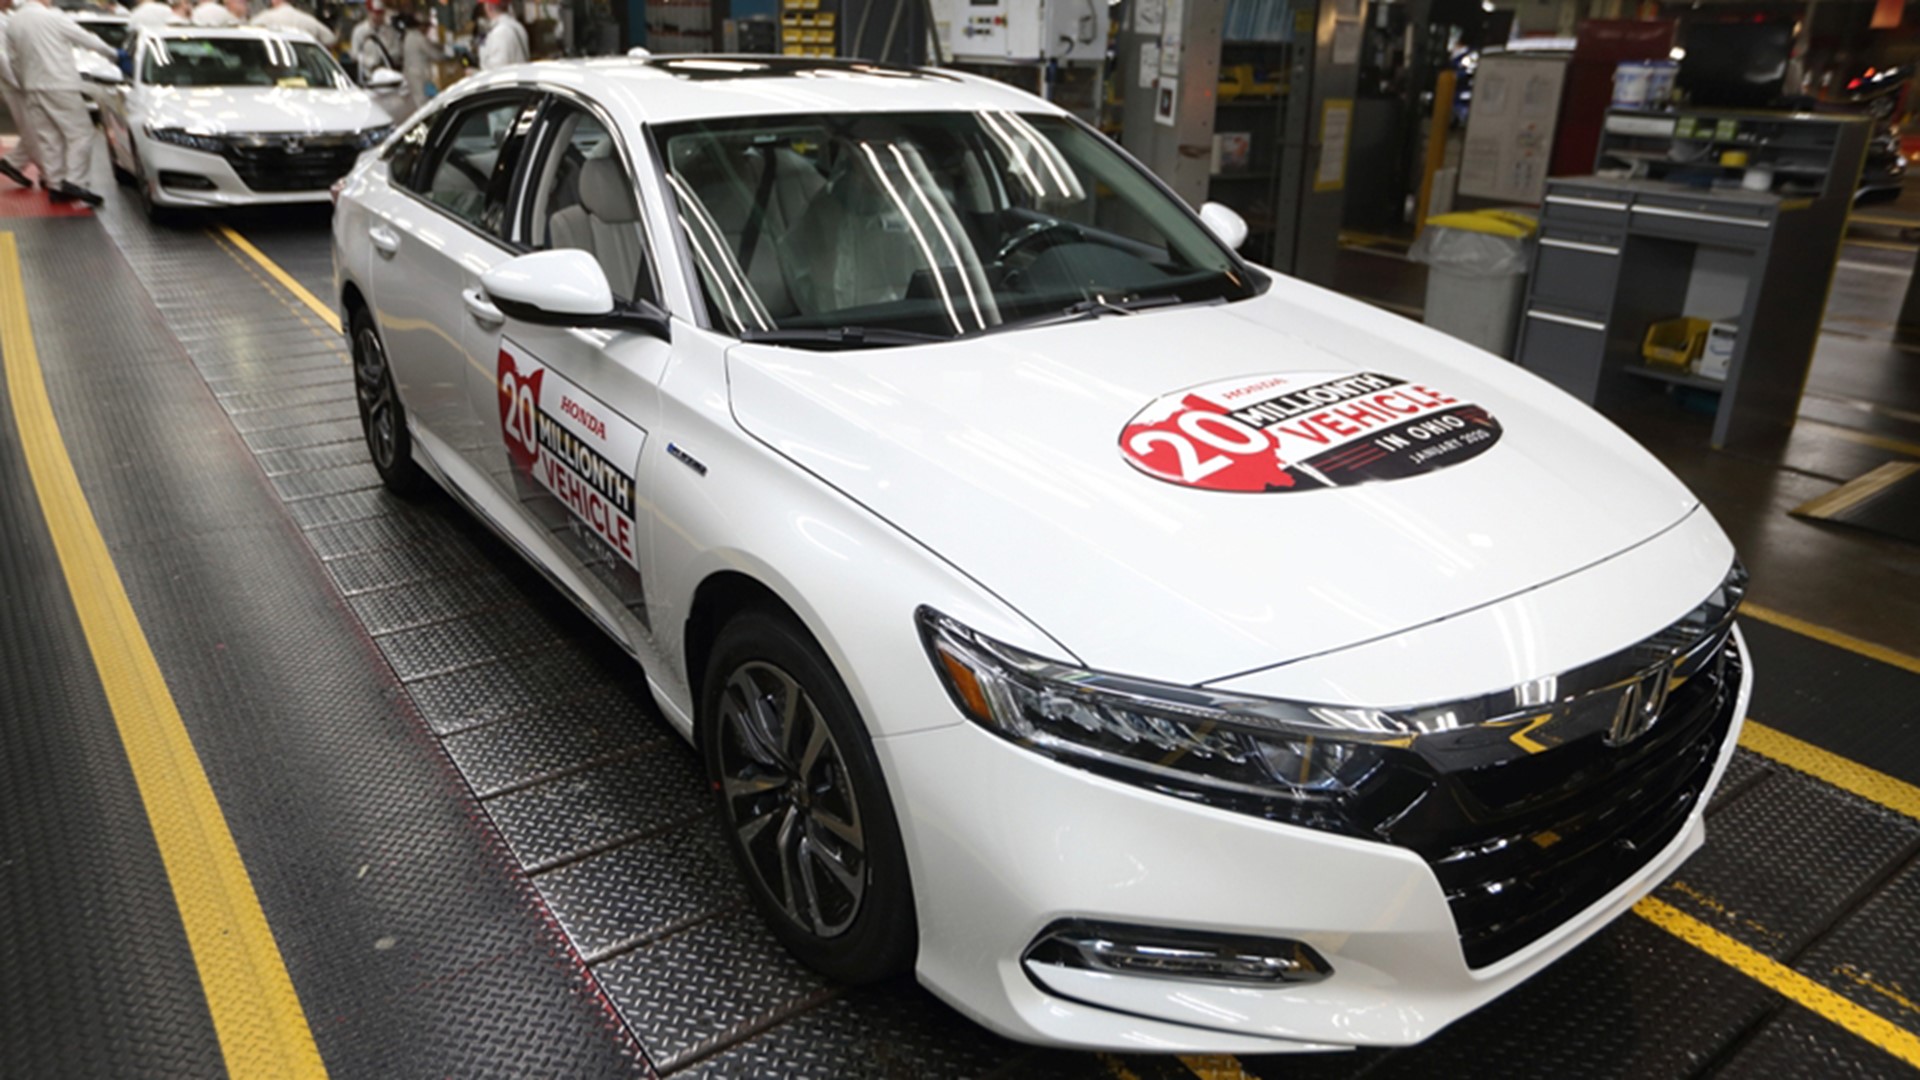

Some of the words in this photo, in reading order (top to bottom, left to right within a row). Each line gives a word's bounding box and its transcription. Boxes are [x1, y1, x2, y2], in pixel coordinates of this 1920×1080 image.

[501, 371, 536, 455] 20
[560, 395, 607, 441] HONDA
[1221, 378, 1288, 400] HONDA
[1234, 372, 1390, 428] MILLIONTH
[1277, 385, 1458, 445] VEHICLE
[538, 412, 630, 511] MILLIONTH
[1129, 410, 1270, 483] 20
[1374, 433, 1411, 452] IN
[1407, 415, 1465, 440] OHIO
[1409, 438, 1463, 464] JANUARY
[541, 451, 632, 560] VEHICLE
